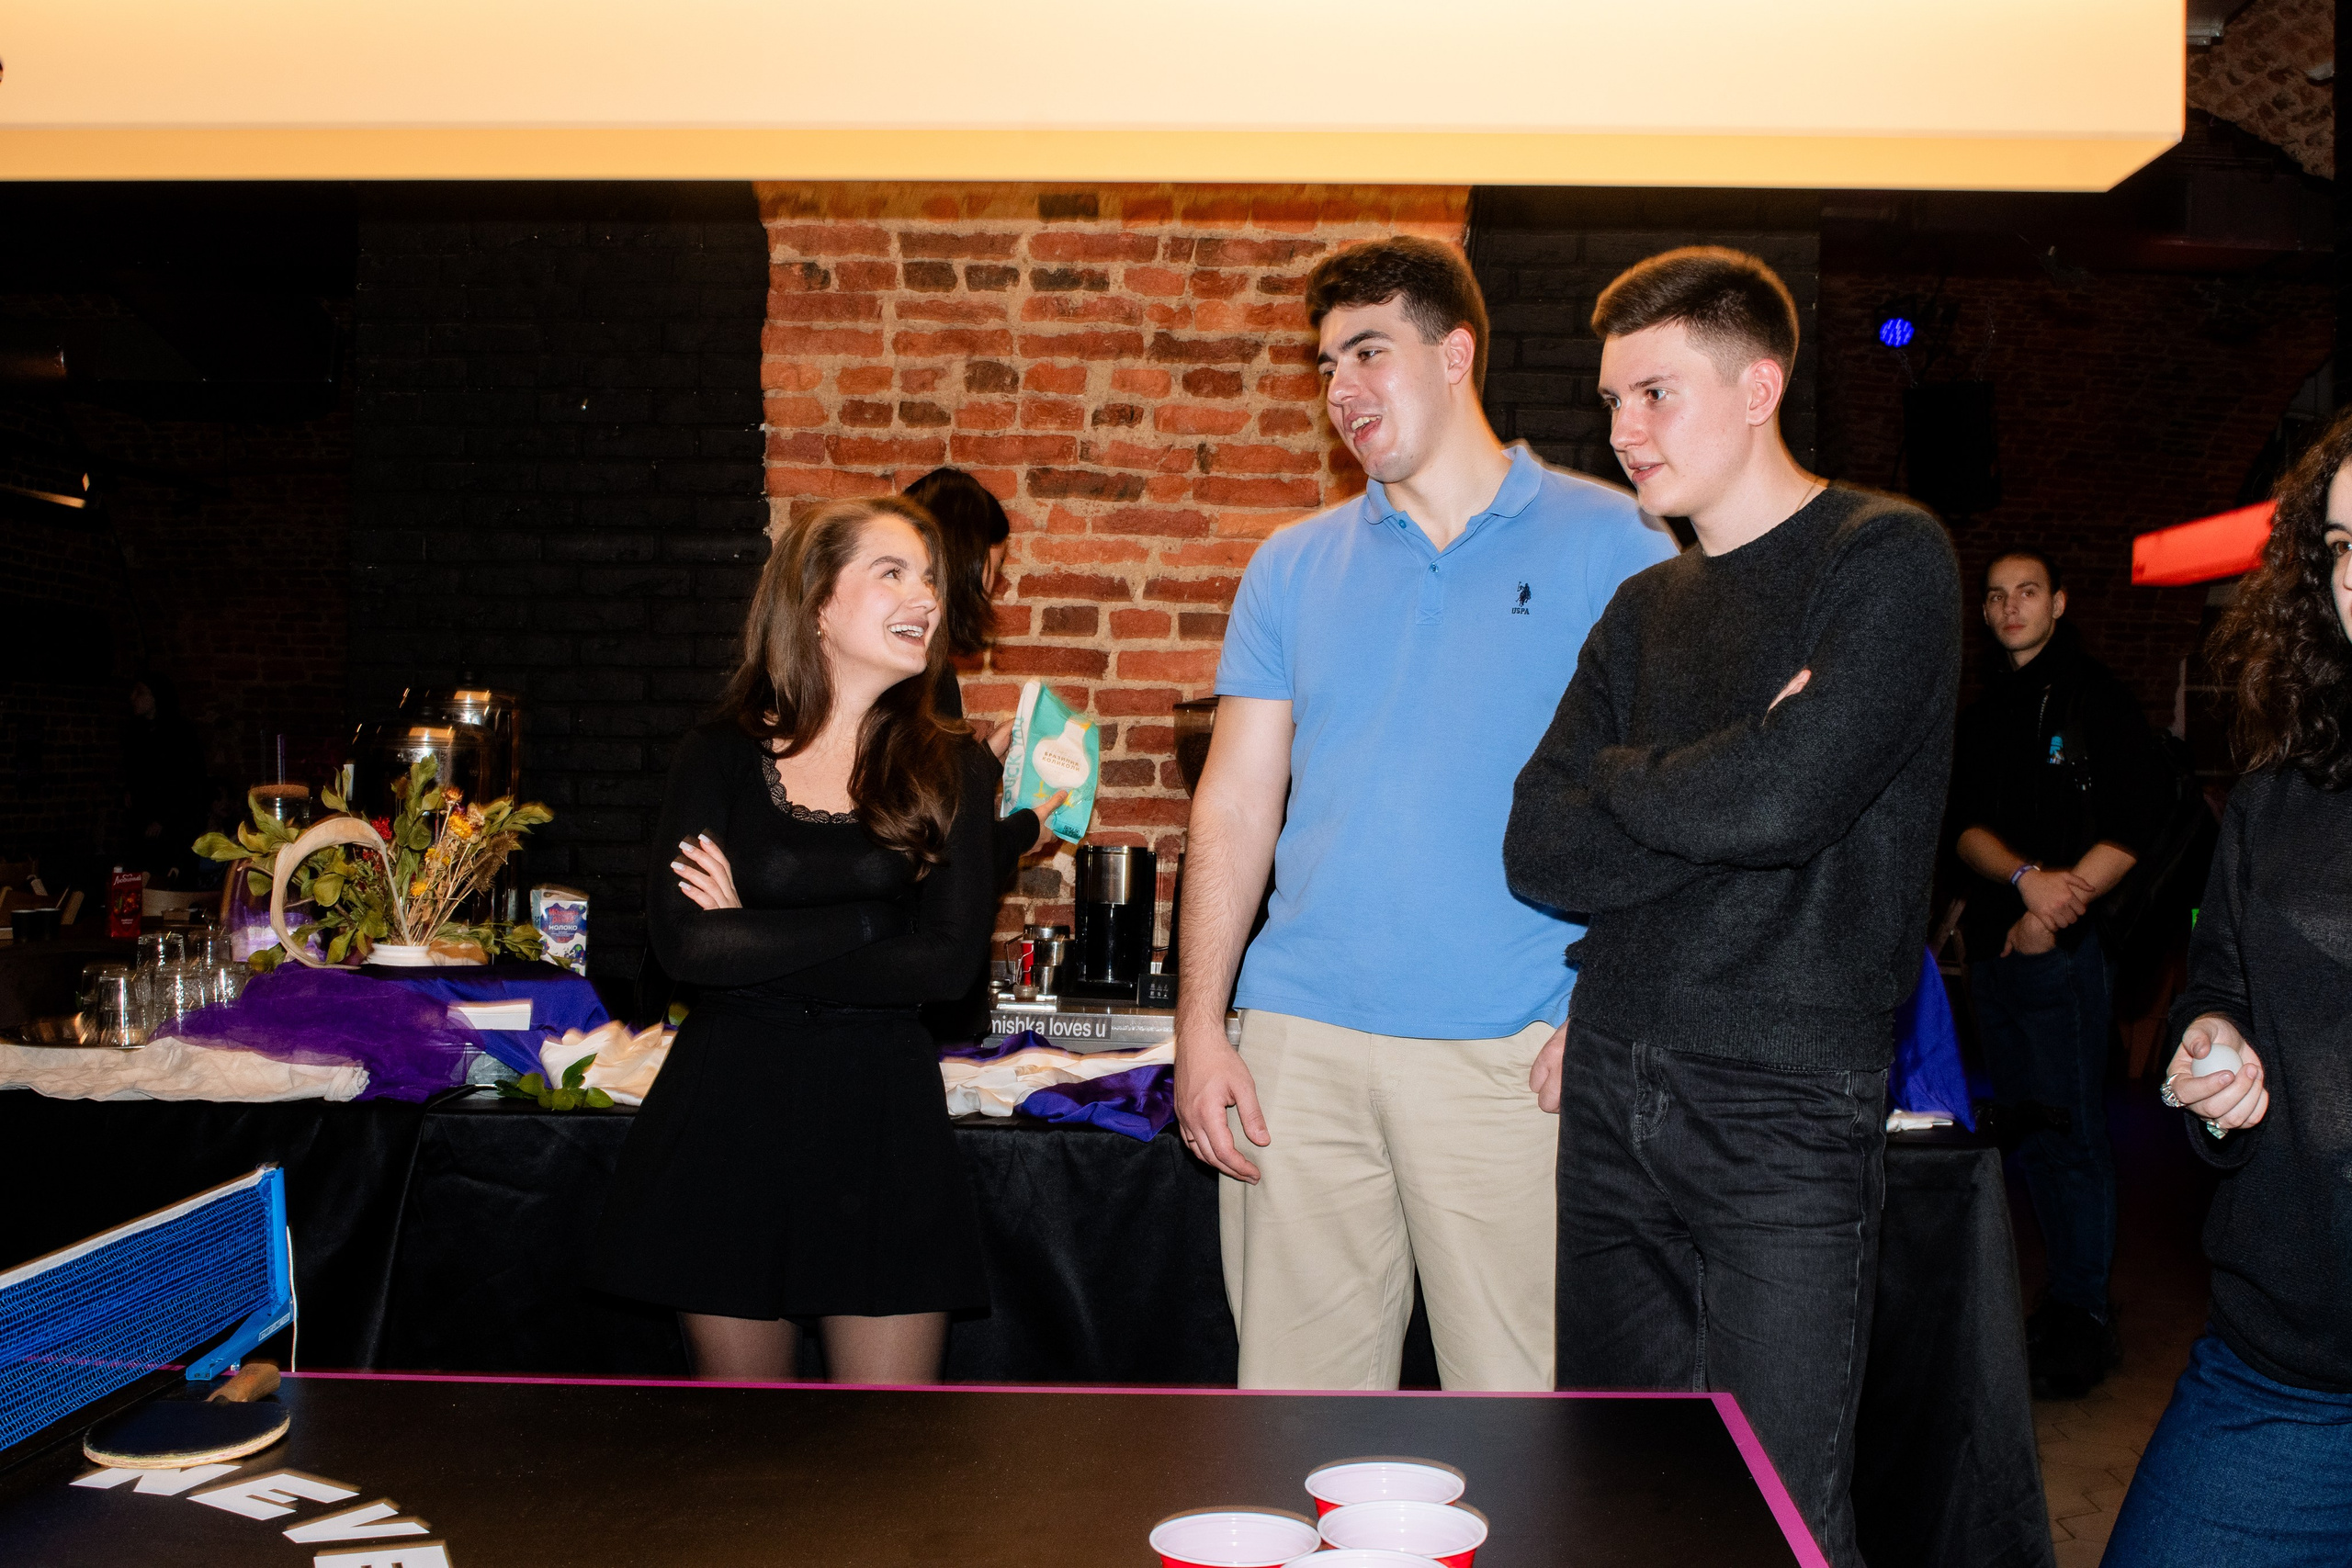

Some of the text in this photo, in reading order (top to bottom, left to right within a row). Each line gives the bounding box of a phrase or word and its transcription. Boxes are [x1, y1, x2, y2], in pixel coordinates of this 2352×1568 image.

[1511, 607, 1530, 615] USPA
[1042, 756, 1080, 772] КОЛИКОЛИ
[1044, 751, 1080, 767] БРАЗИЛИЯ
[1049, 1017, 1091, 1037] loves
[1095, 1023, 1106, 1038] u
